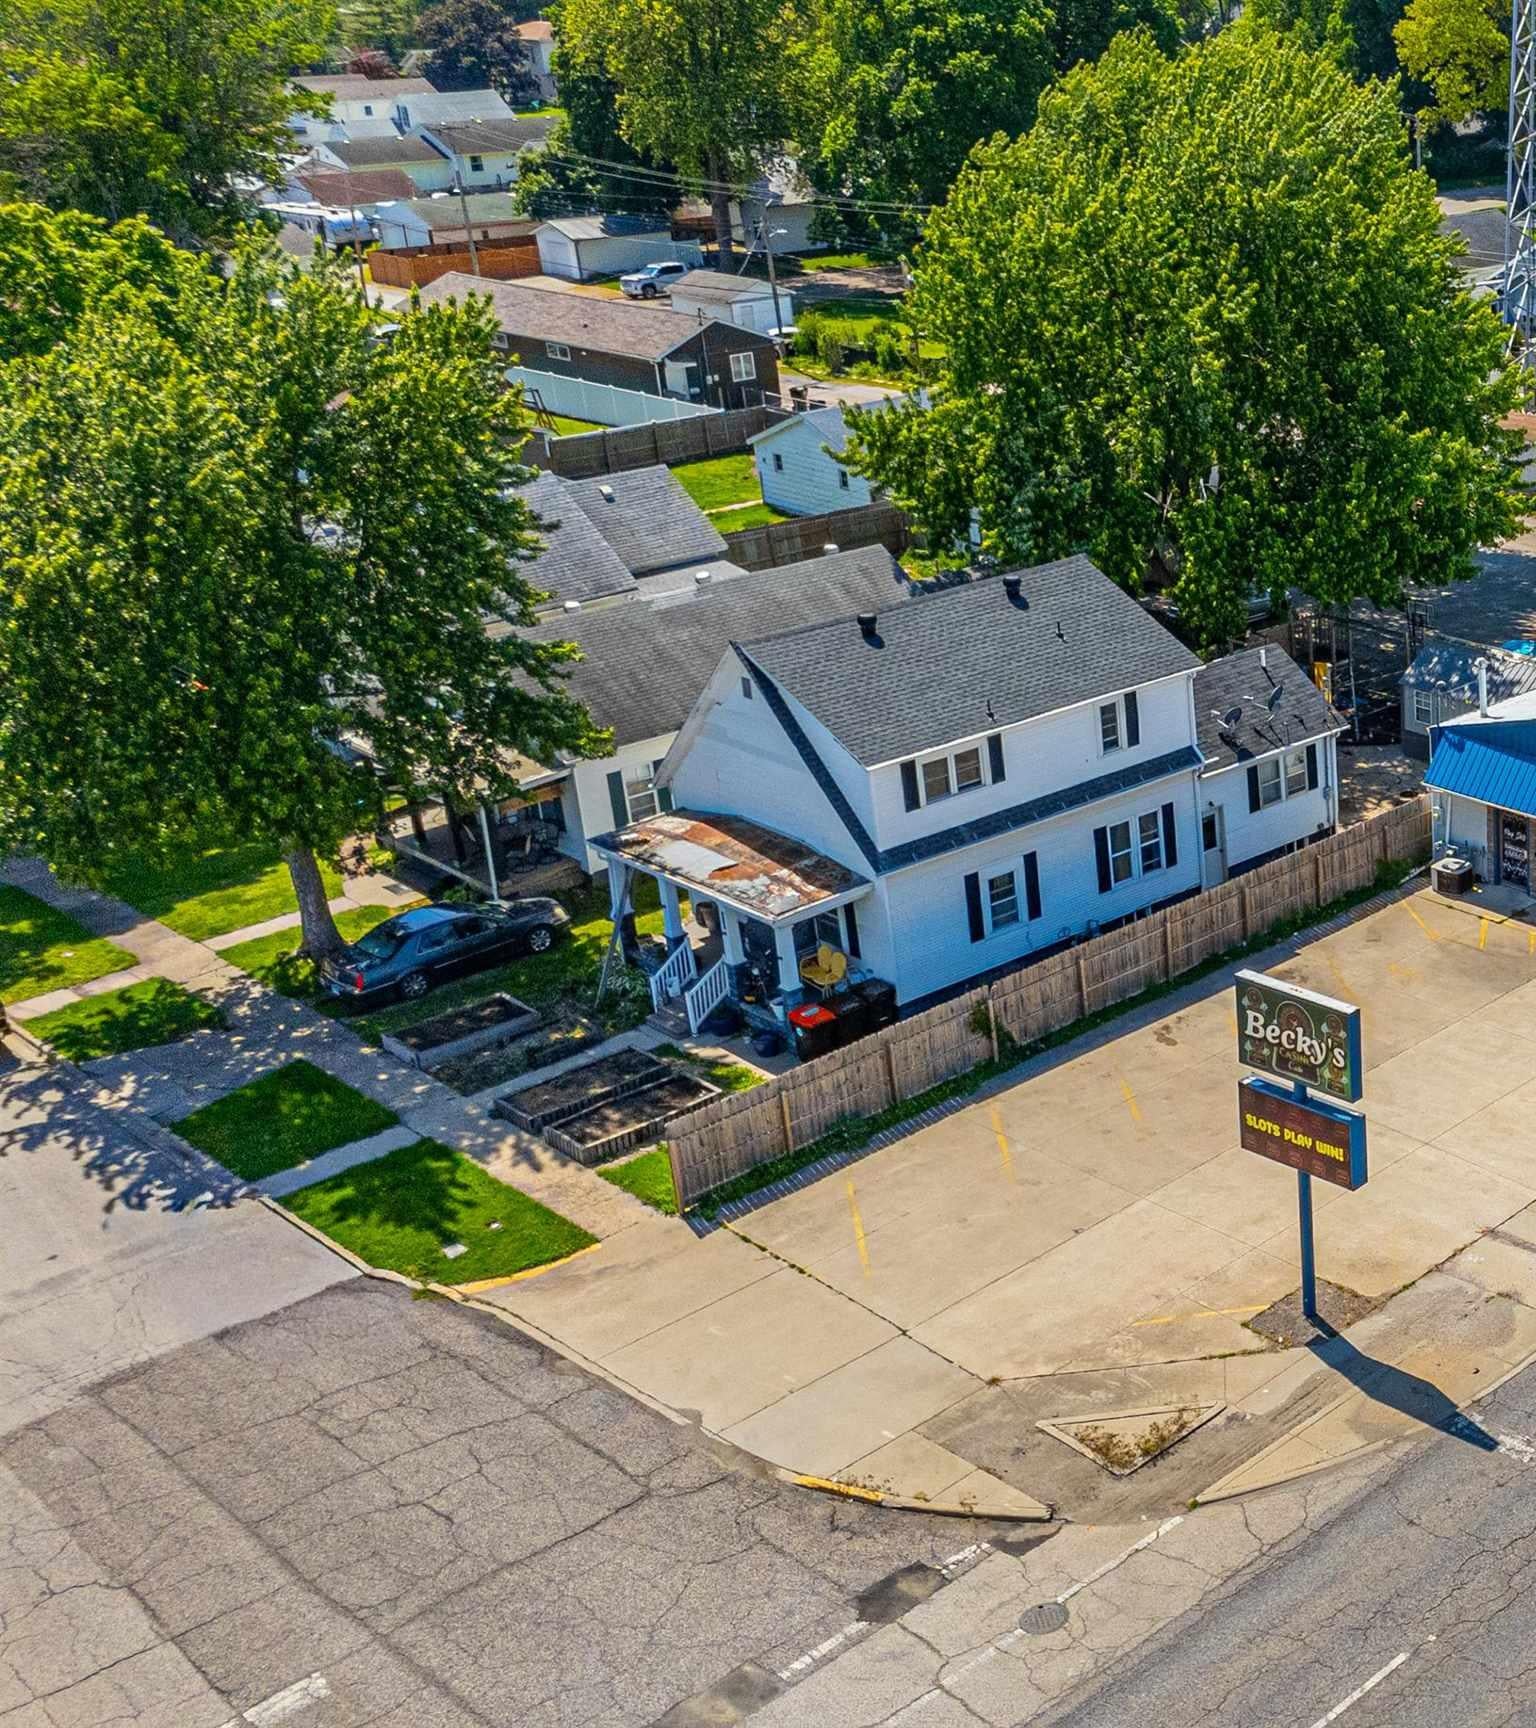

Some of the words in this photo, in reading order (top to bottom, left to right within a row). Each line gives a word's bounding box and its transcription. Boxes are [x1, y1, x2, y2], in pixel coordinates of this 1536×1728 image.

[1244, 1009, 1345, 1068] Becky's
[1245, 1113, 1281, 1137] SLOTS
[1283, 1128, 1313, 1150] PLAY
[1315, 1140, 1345, 1162] WIN!
